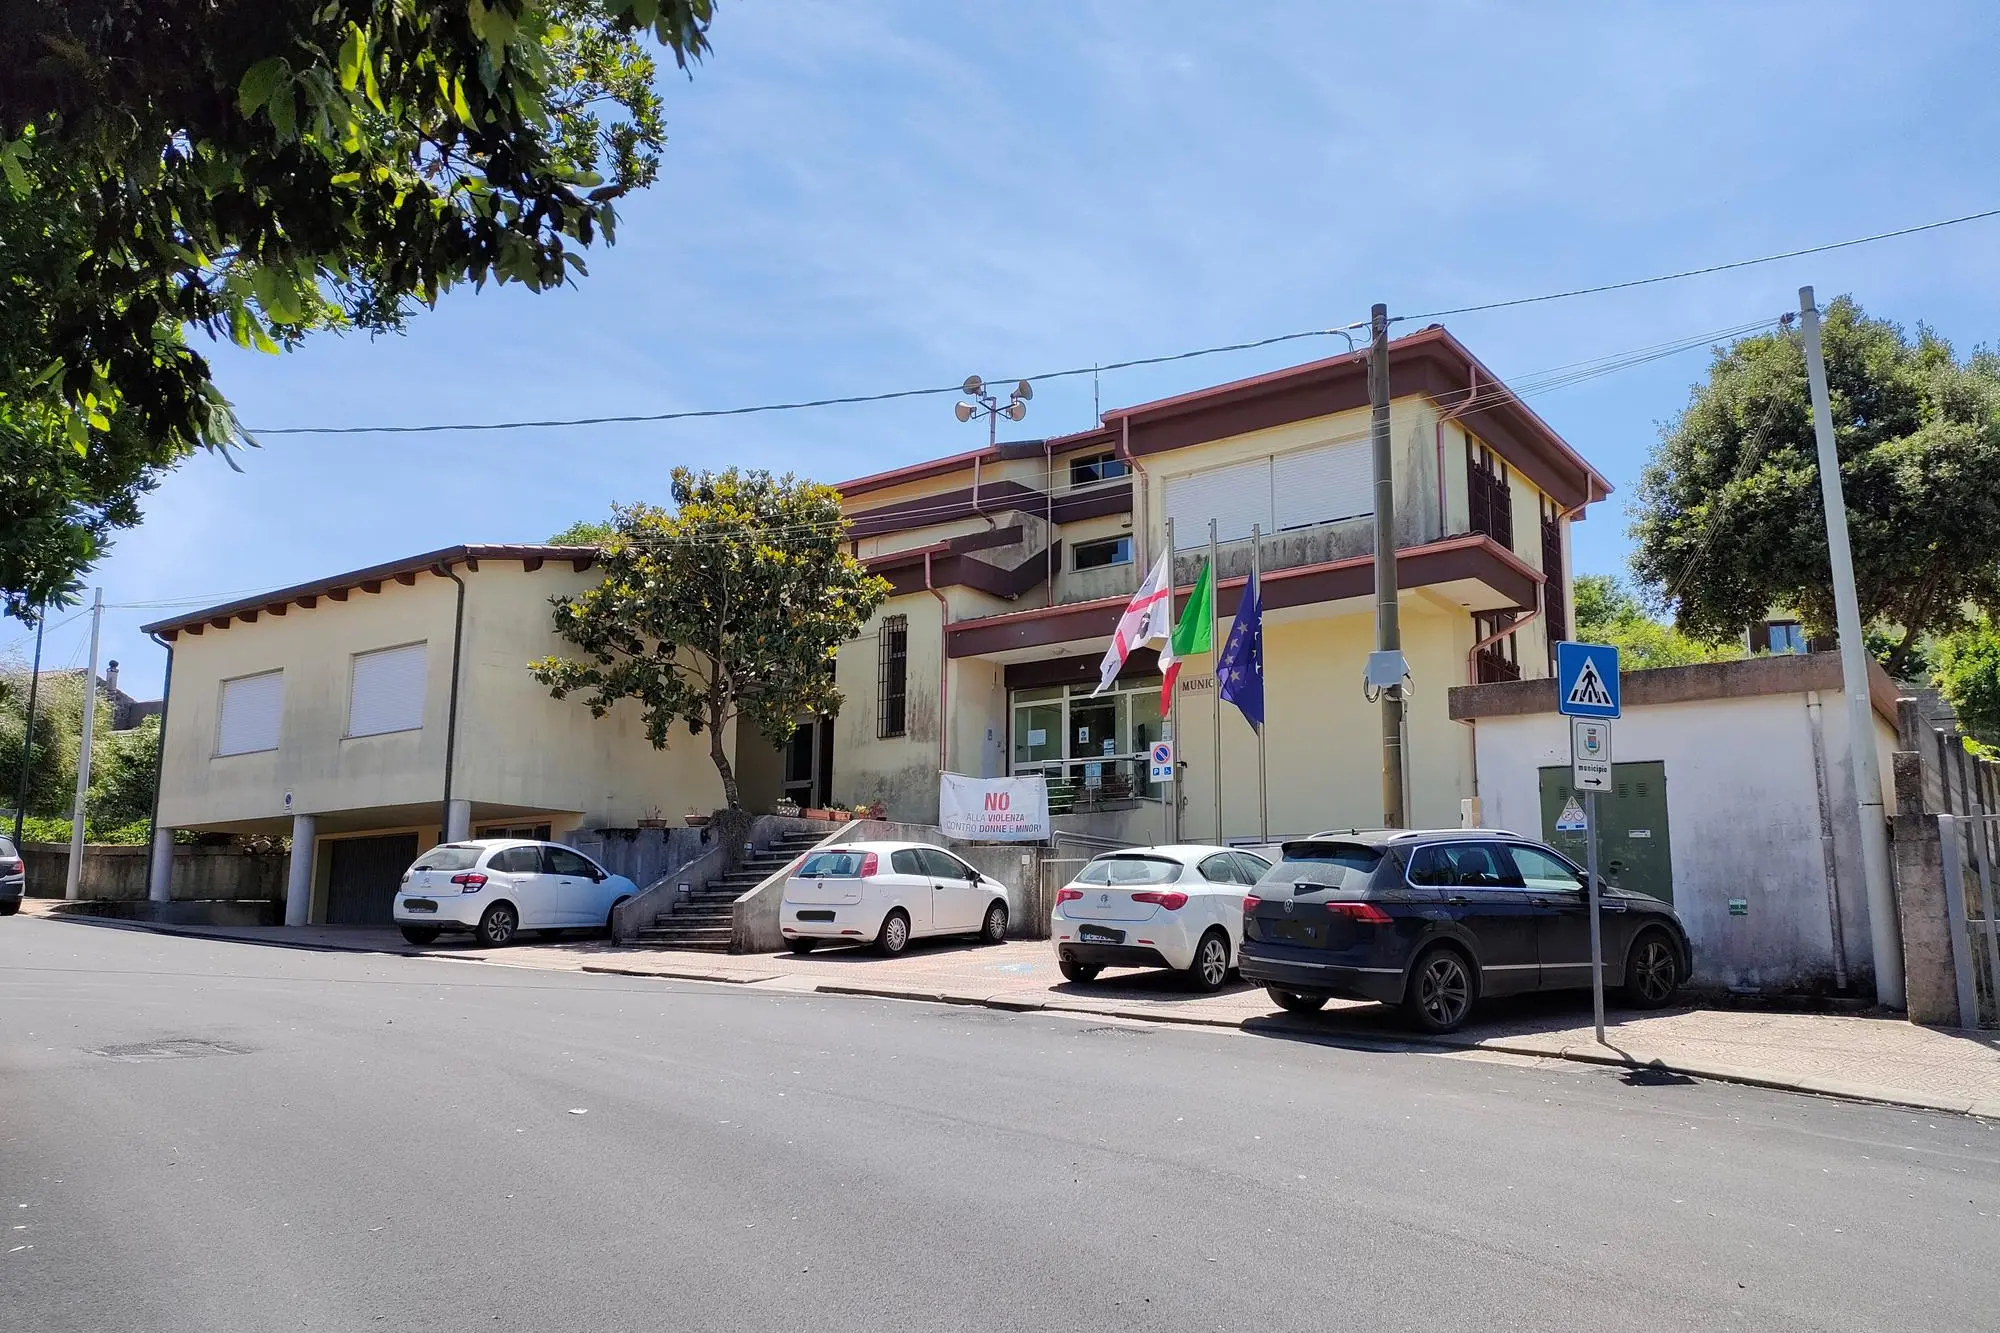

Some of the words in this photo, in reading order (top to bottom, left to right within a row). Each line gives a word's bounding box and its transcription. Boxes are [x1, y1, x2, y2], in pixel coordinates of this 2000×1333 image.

[1182, 678, 1214, 691] MUNIC
[1578, 764, 1607, 774] municipio
[984, 792, 1010, 811] NO
[966, 813, 985, 822] ALLA
[988, 813, 1025, 822] VIOLENZA
[946, 820, 977, 833] CONTRO
[979, 824, 1007, 833] DONNE
